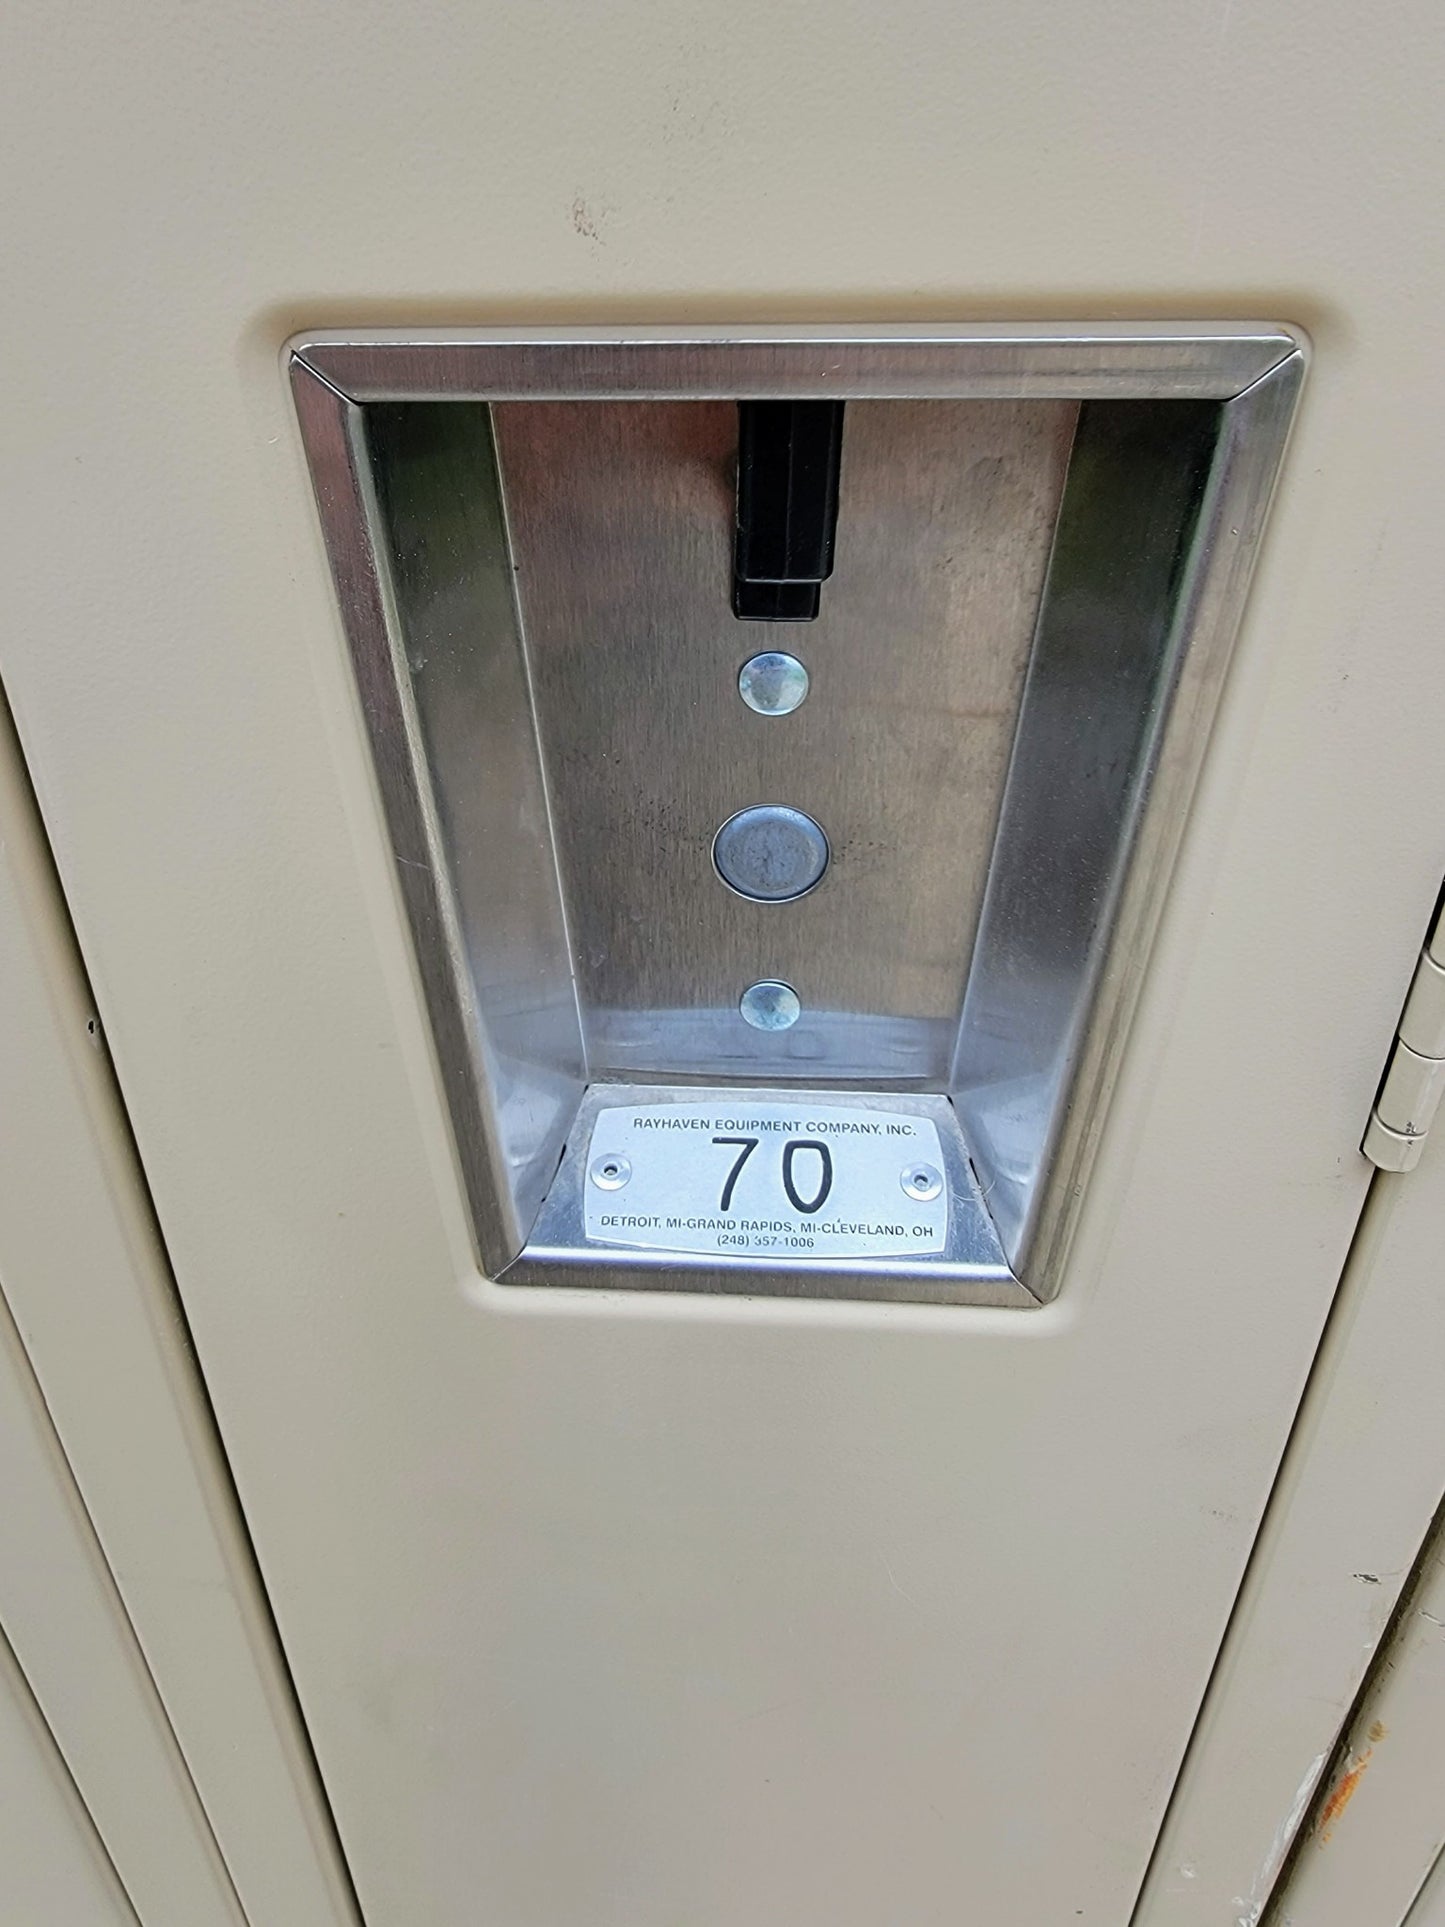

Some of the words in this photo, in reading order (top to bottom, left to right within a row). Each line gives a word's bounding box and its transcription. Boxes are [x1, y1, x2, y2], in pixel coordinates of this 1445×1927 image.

[633, 1117, 710, 1130] RAYHAVEN
[715, 1119, 802, 1133] EQUIPMENT
[805, 1120, 883, 1136] COMPANY,
[886, 1123, 917, 1137] INC.
[711, 1136, 833, 1214] 70
[600, 1215, 662, 1229] DETROIT,
[666, 1217, 737, 1231] MI-GRAND
[740, 1219, 797, 1234] RAPIDS,
[800, 1222, 909, 1238] MI-CLEVELAND,
[912, 1225, 934, 1238] OH
[716, 1234, 750, 1248] (248)
[754, 1235, 815, 1249] 357-1006
